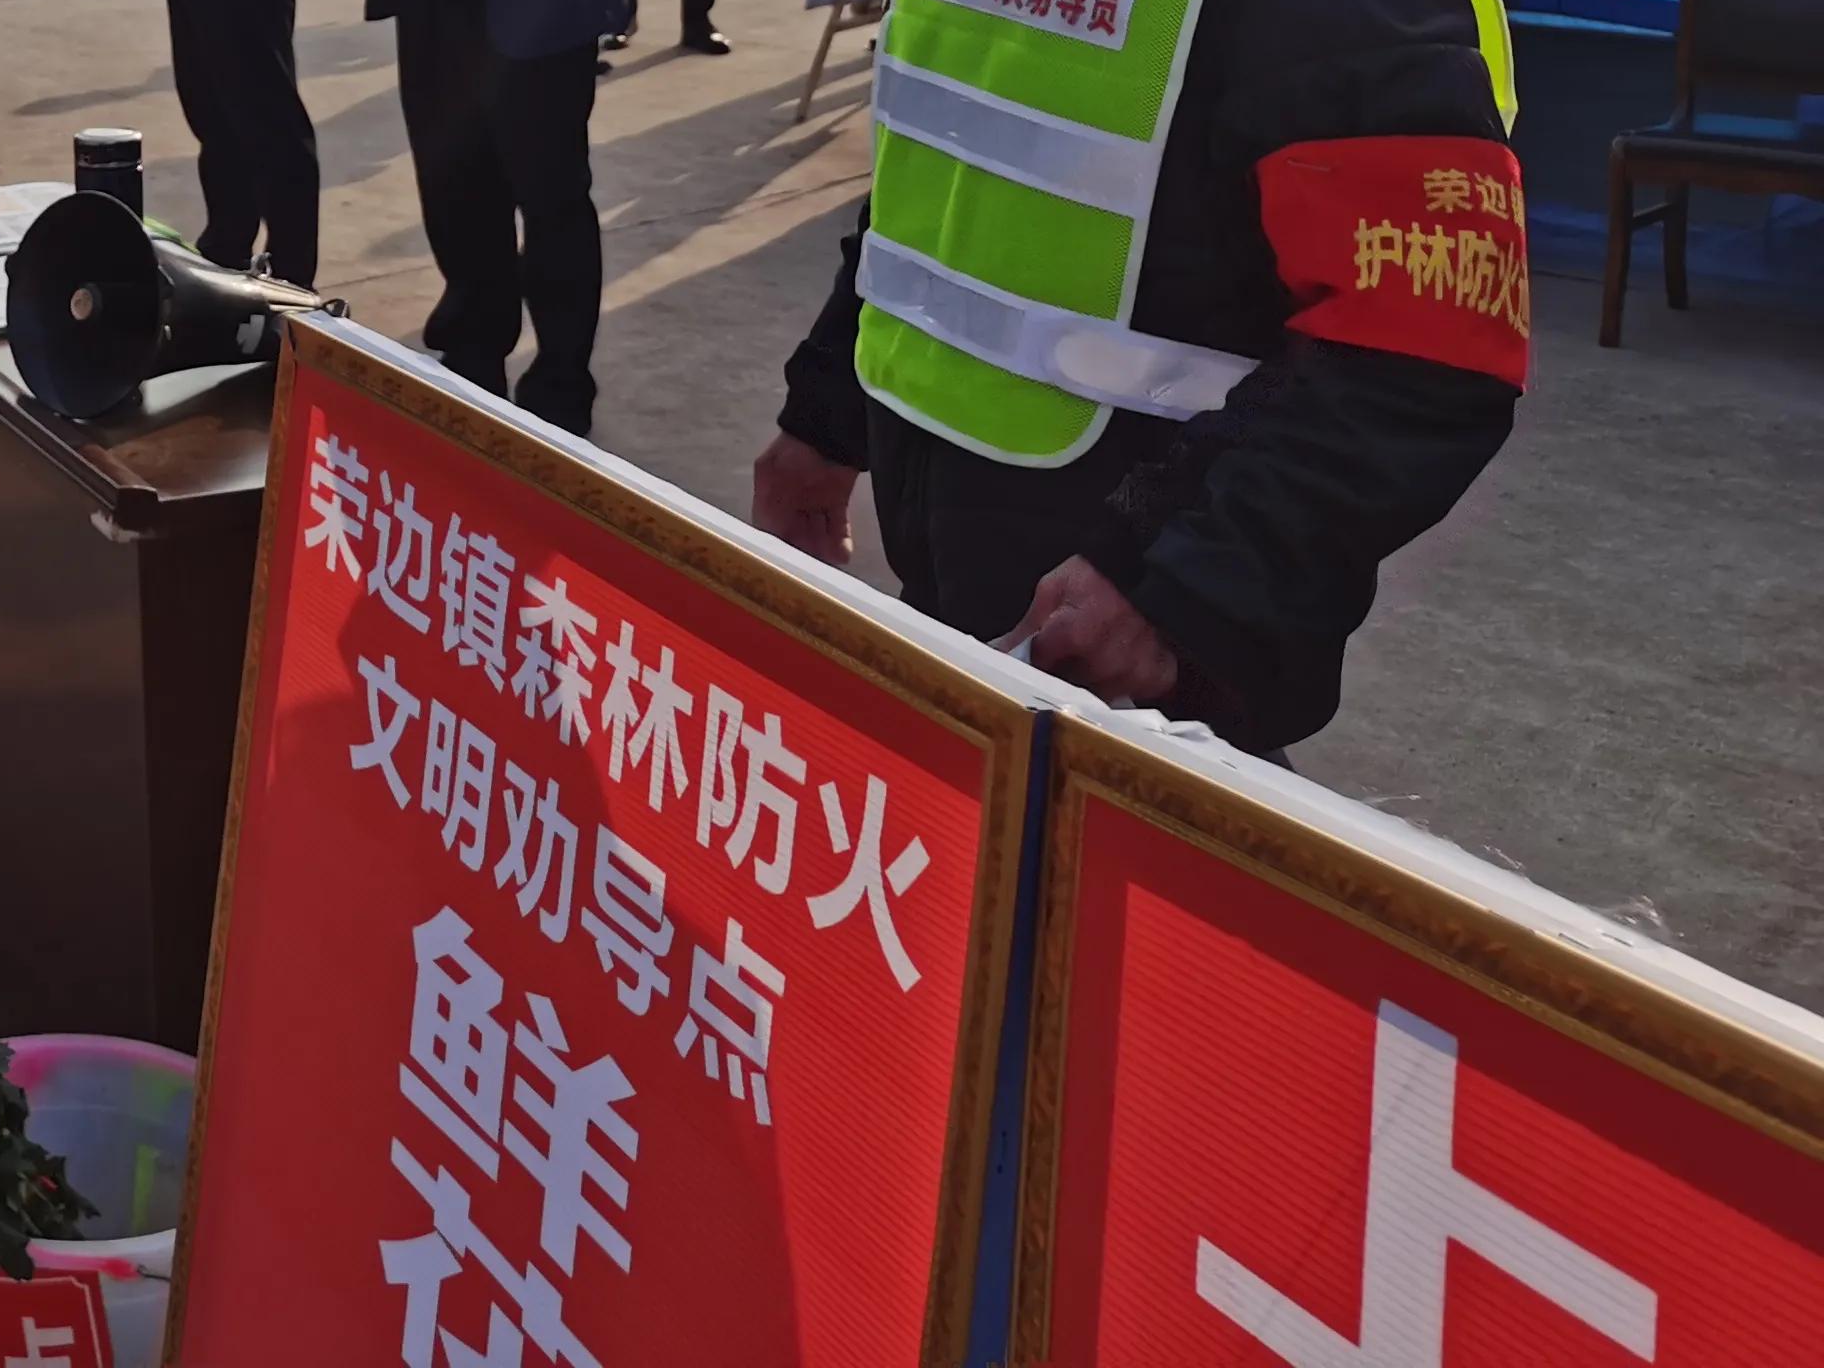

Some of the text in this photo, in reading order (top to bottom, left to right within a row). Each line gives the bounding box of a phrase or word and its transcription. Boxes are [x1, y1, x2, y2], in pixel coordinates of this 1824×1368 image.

[304, 433, 931, 993] 荣边镇森林防火
[348, 654, 786, 1126] 文明劝导点
